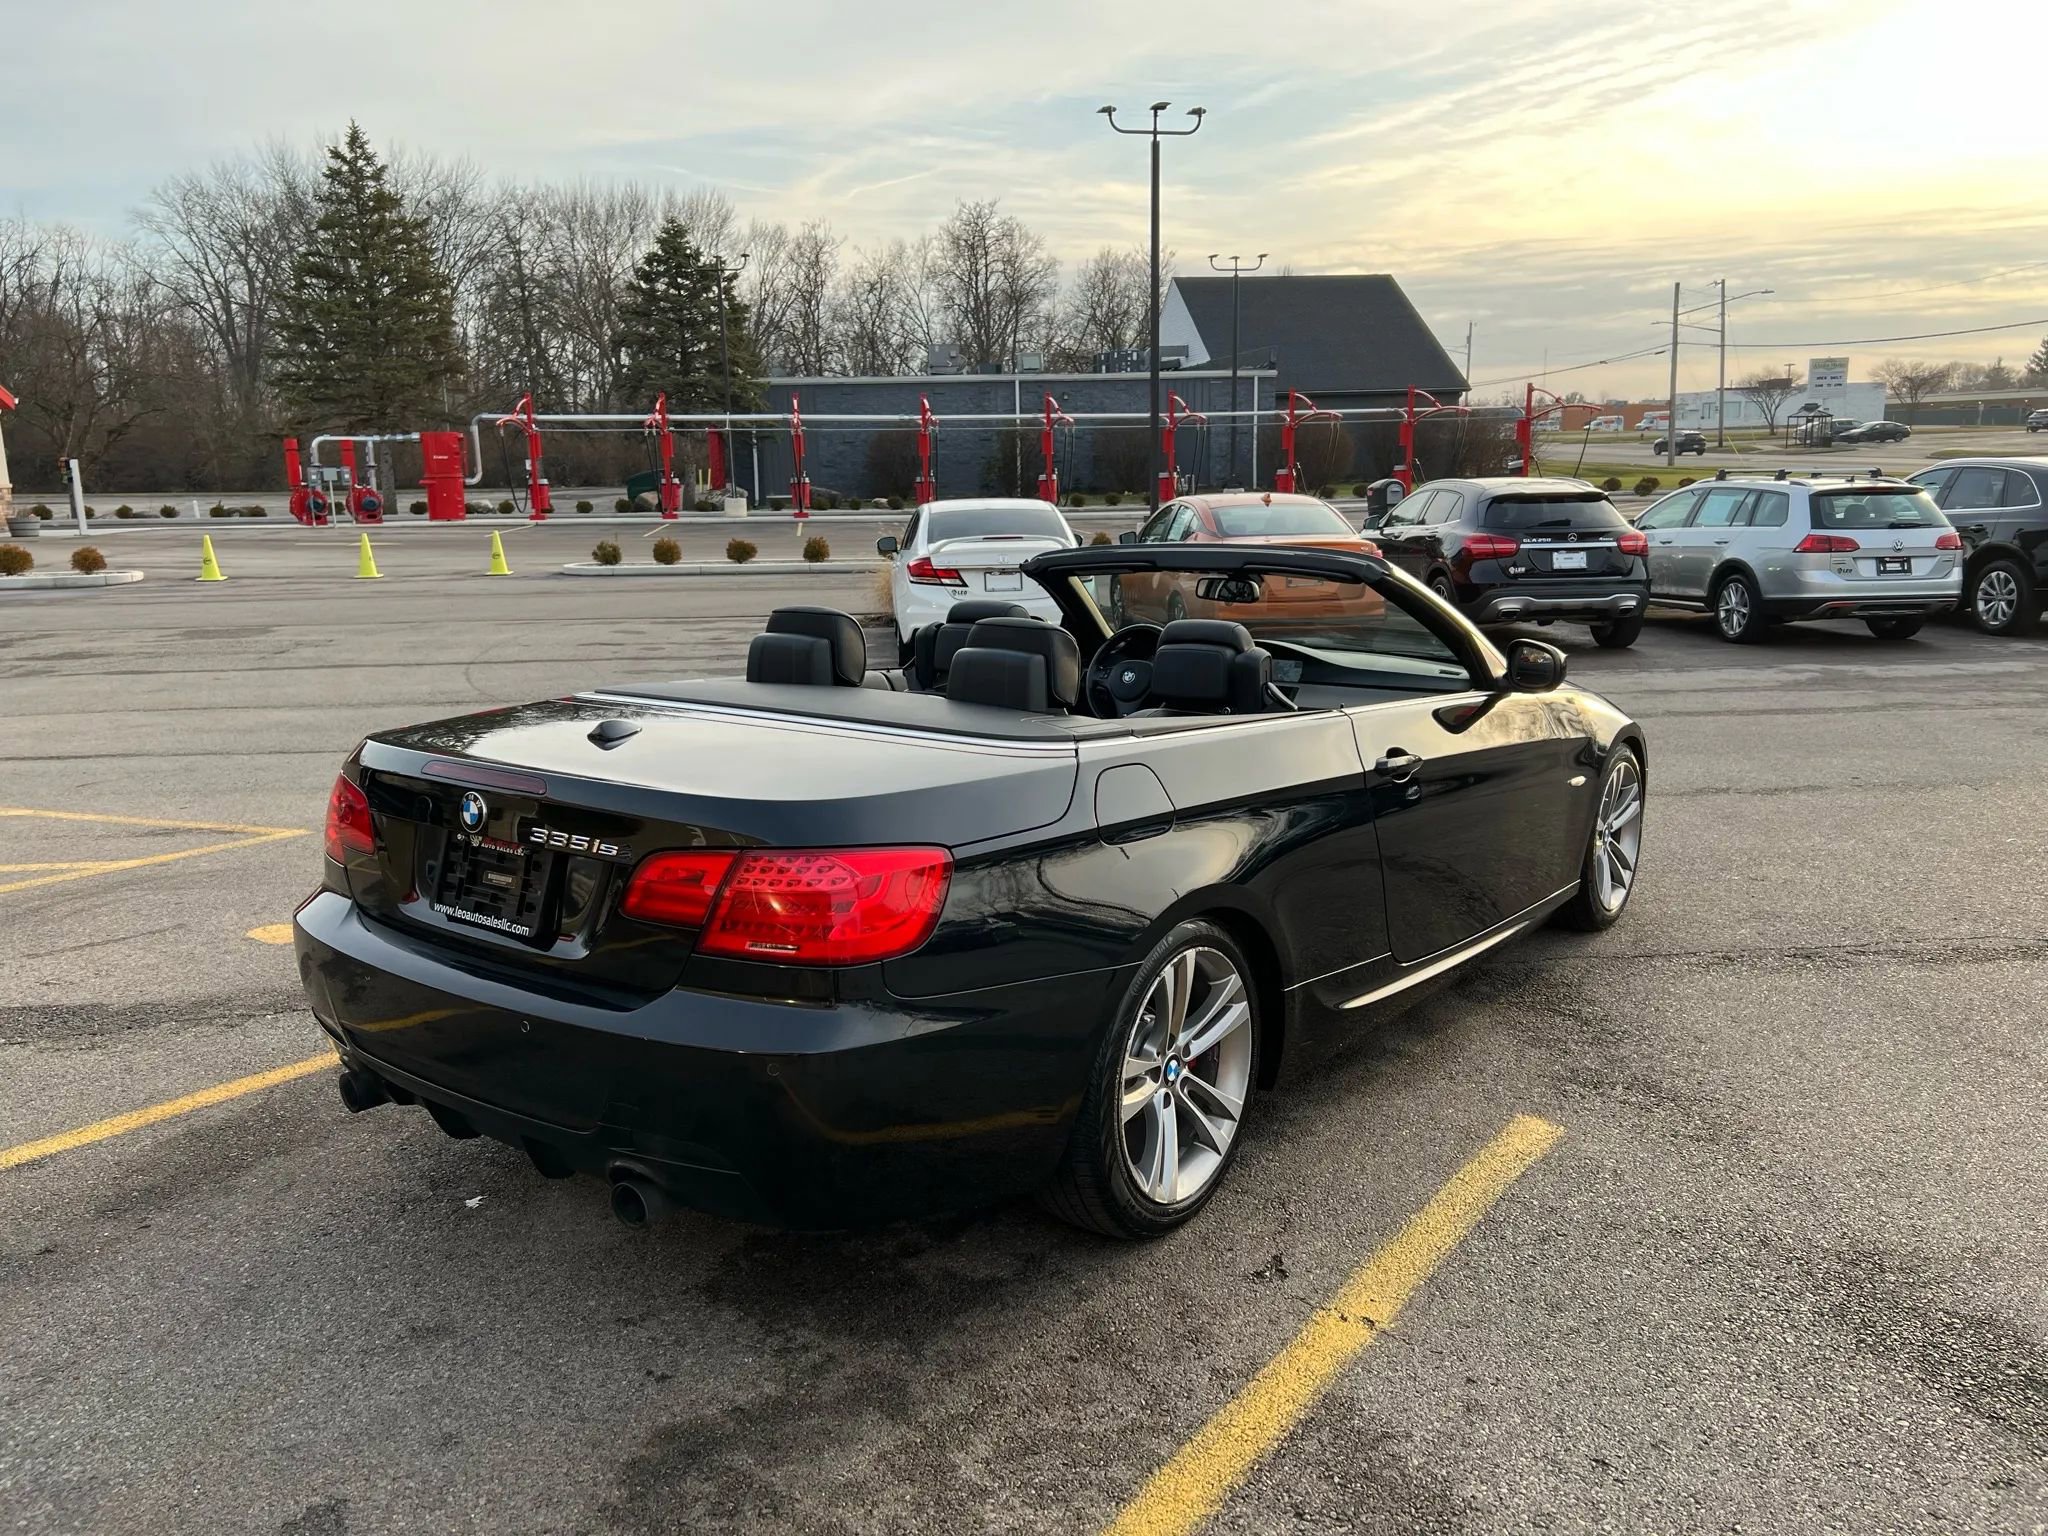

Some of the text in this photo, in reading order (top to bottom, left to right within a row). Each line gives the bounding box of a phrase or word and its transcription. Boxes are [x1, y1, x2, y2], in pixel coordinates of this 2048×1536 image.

[481, 842, 496, 850] AUTO
[496, 846, 514, 855] SALES
[434, 902, 530, 937] www.leoautosalesllc.com
